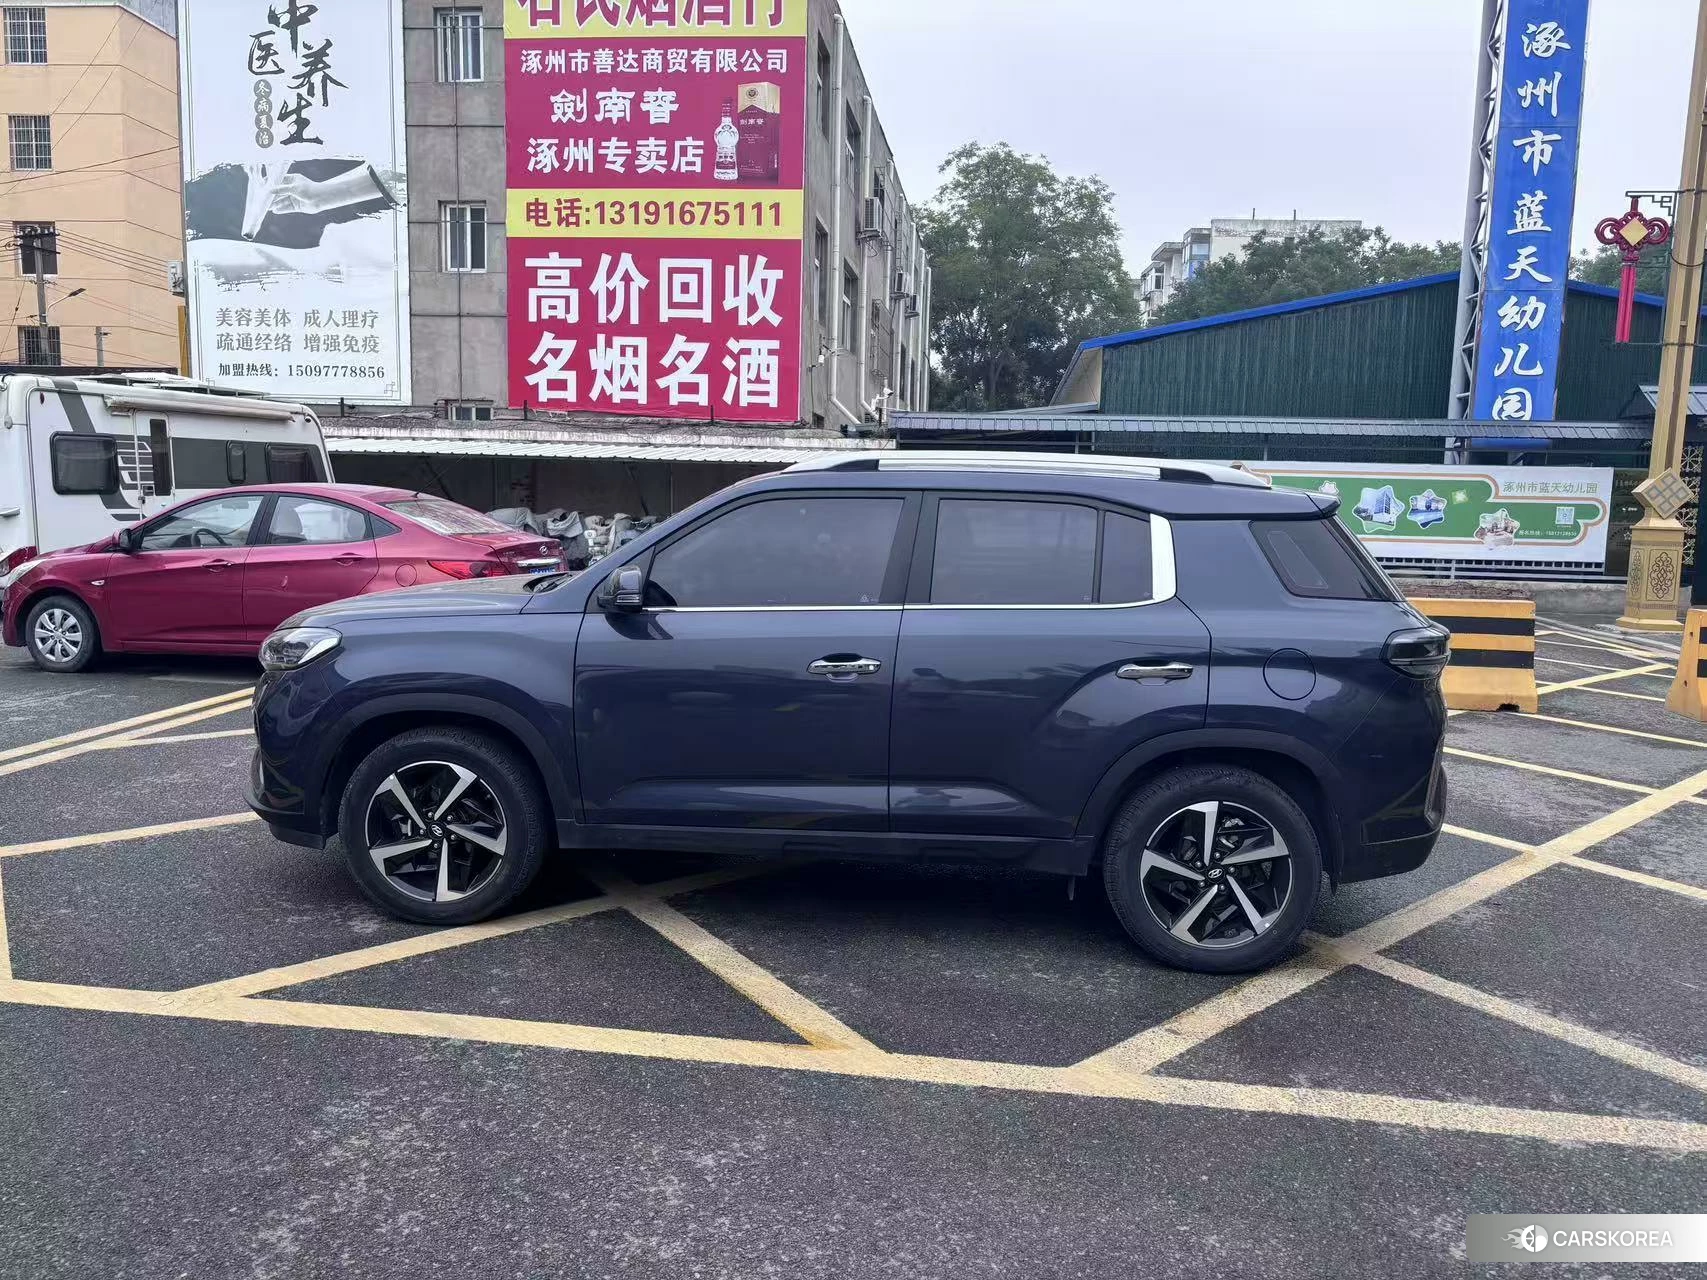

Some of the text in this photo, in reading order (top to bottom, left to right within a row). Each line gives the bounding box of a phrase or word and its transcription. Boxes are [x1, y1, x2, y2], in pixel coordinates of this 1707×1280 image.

[520, 47, 788, 74] 涿州市善达商贸有限公司
[254, 79, 274, 148] 冬病夏治
[526, 137, 705, 174] 涿州专卖店
[1492, 21, 1571, 421] 涿州市蓝天幼儿园
[524, 252, 784, 327] 高价回收
[216, 307, 379, 329] 美容美体 成人理疗
[216, 333, 380, 354] 疏通经络 增强免疫
[524, 331, 781, 408] 名烟名酒
[1503, 482, 1598, 494] 涿州市蓝天幼儿园
